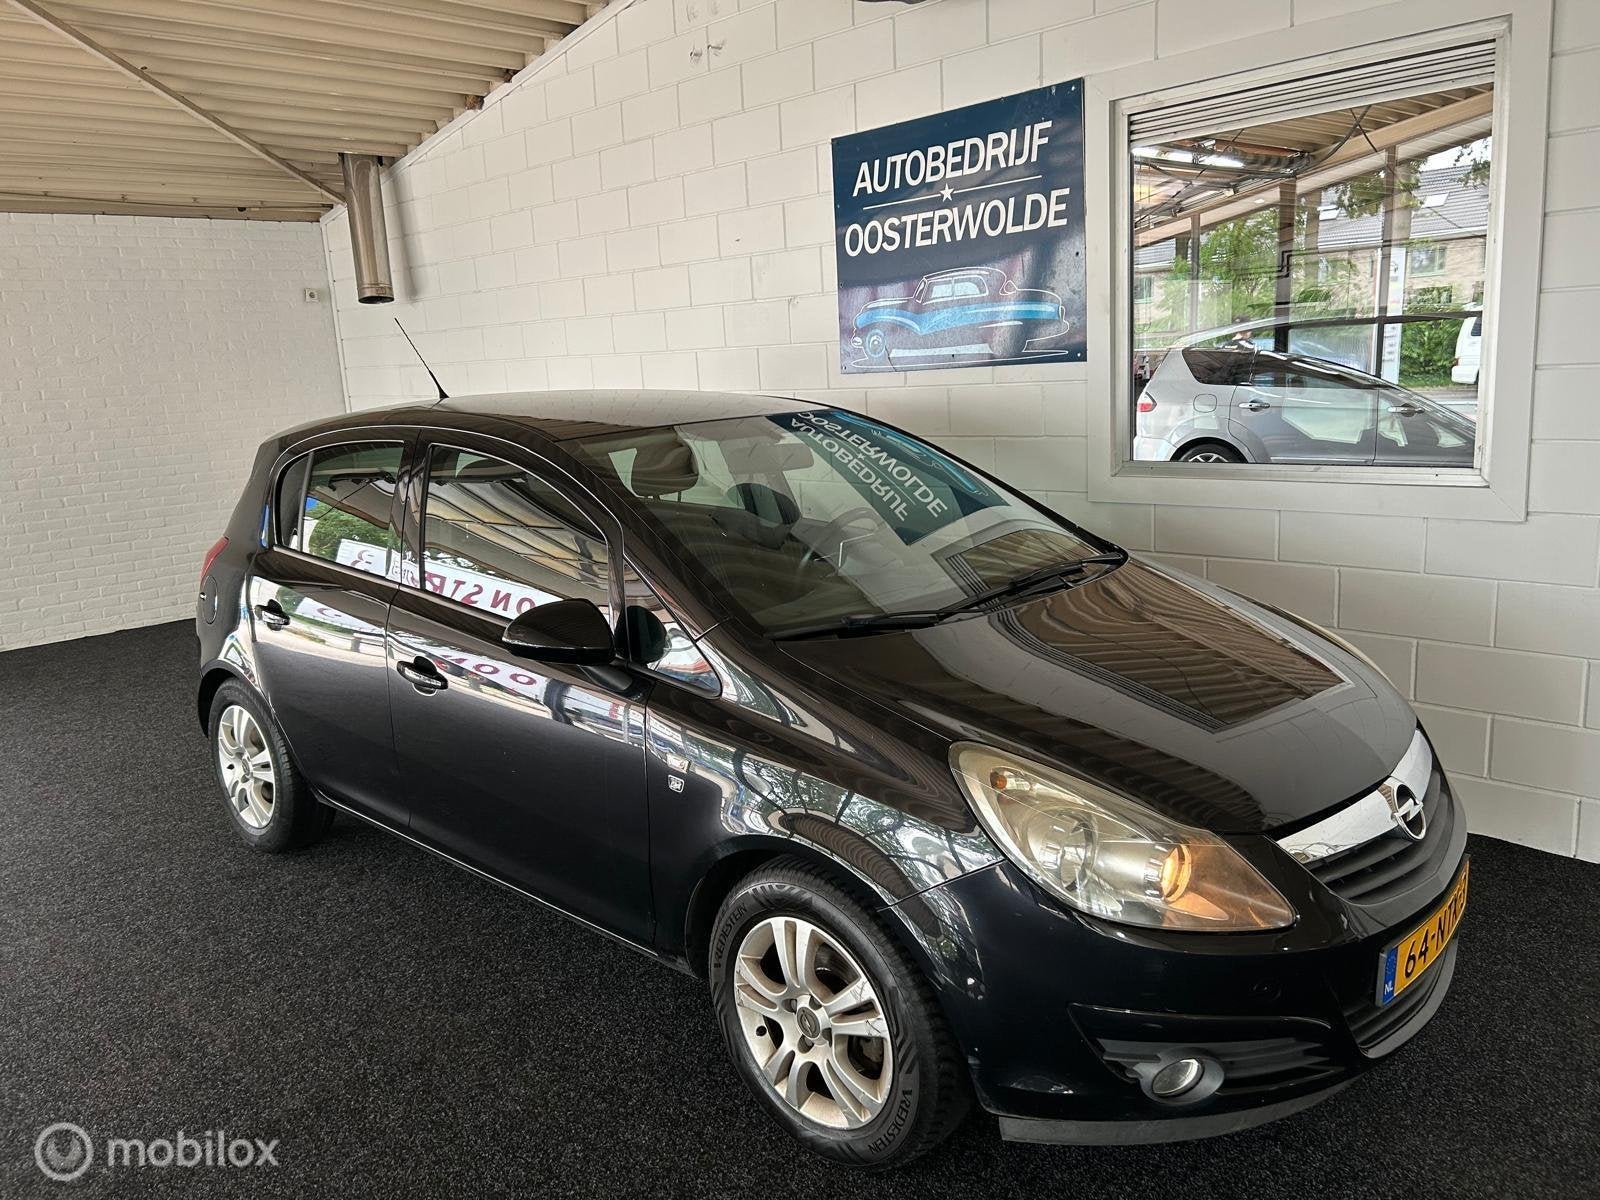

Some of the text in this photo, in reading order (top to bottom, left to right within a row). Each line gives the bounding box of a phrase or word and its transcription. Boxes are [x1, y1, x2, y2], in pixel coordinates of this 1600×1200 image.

[852, 120, 1053, 197] AUTOBEDRIJF
[844, 187, 1070, 257] OOSTERWOLDE
[1384, 981, 1394, 996] NL
